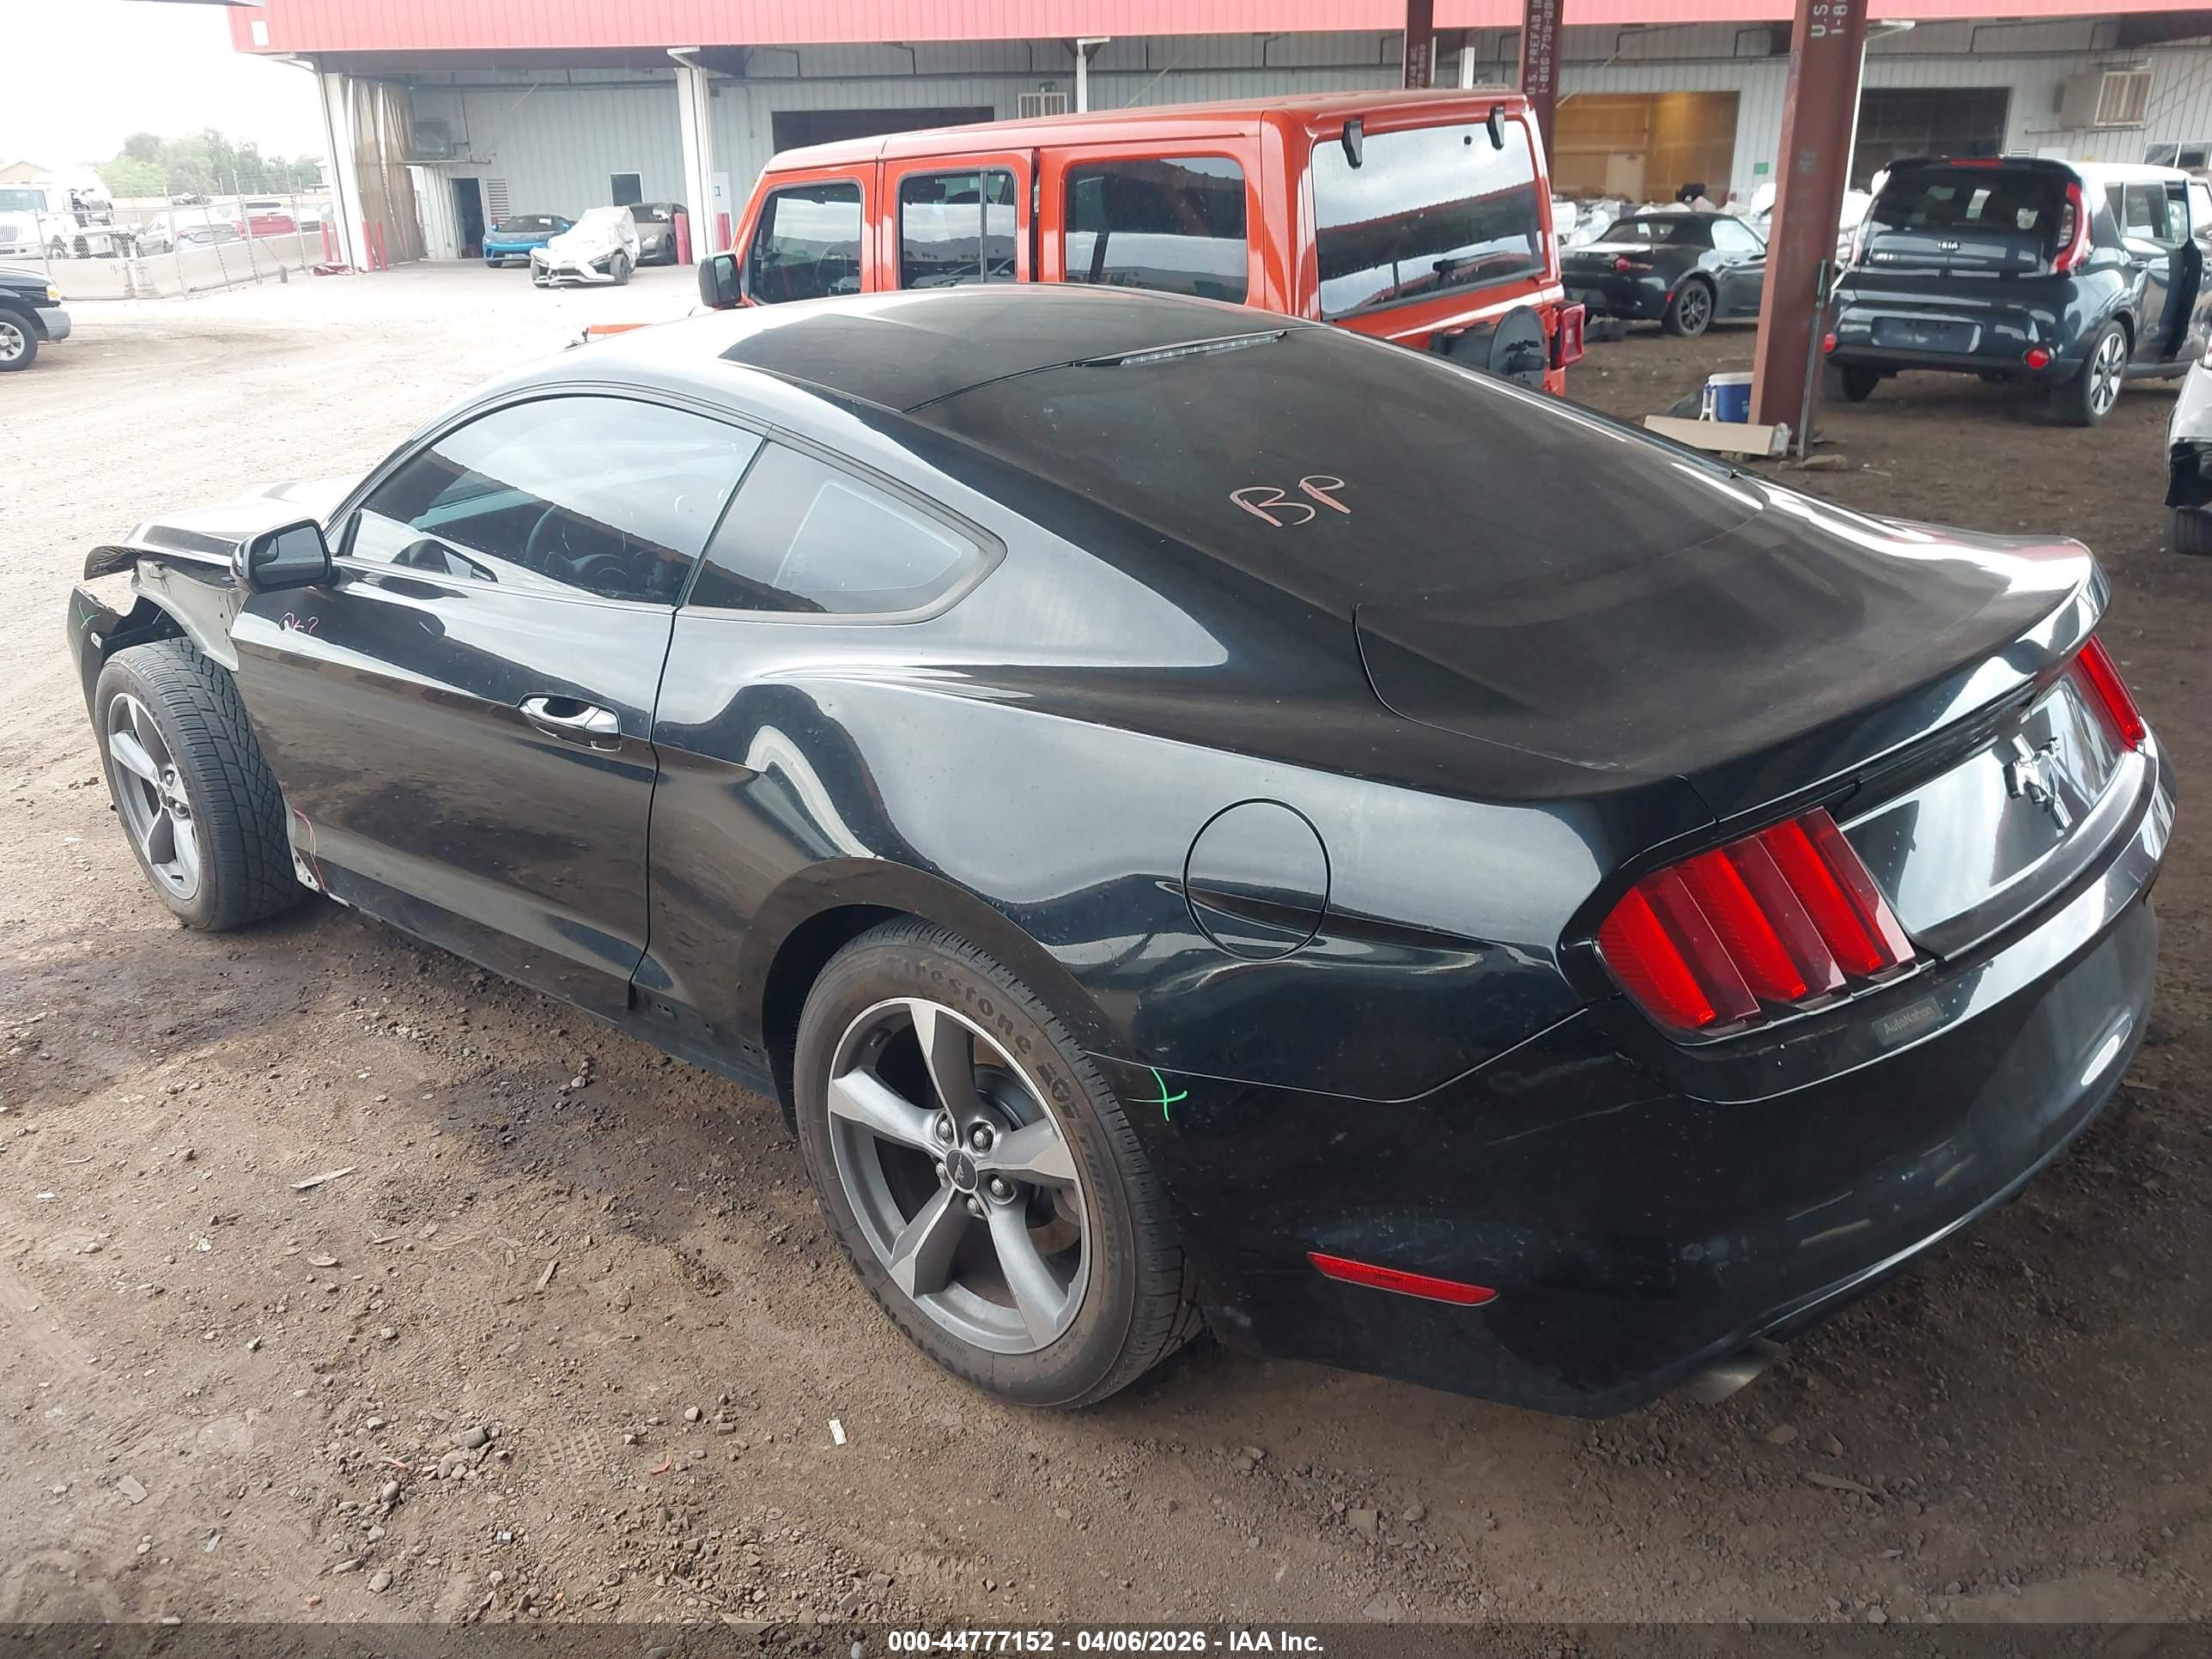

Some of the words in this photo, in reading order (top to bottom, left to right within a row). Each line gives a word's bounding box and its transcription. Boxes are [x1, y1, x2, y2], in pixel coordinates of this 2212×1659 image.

[1538, 0, 1554, 94] 1-866-709-00
[1830, 0, 1848, 35] 1-8
[885, 956, 1030, 1054] Firestone
[1882, 1006, 1936, 1036] AutoNation
